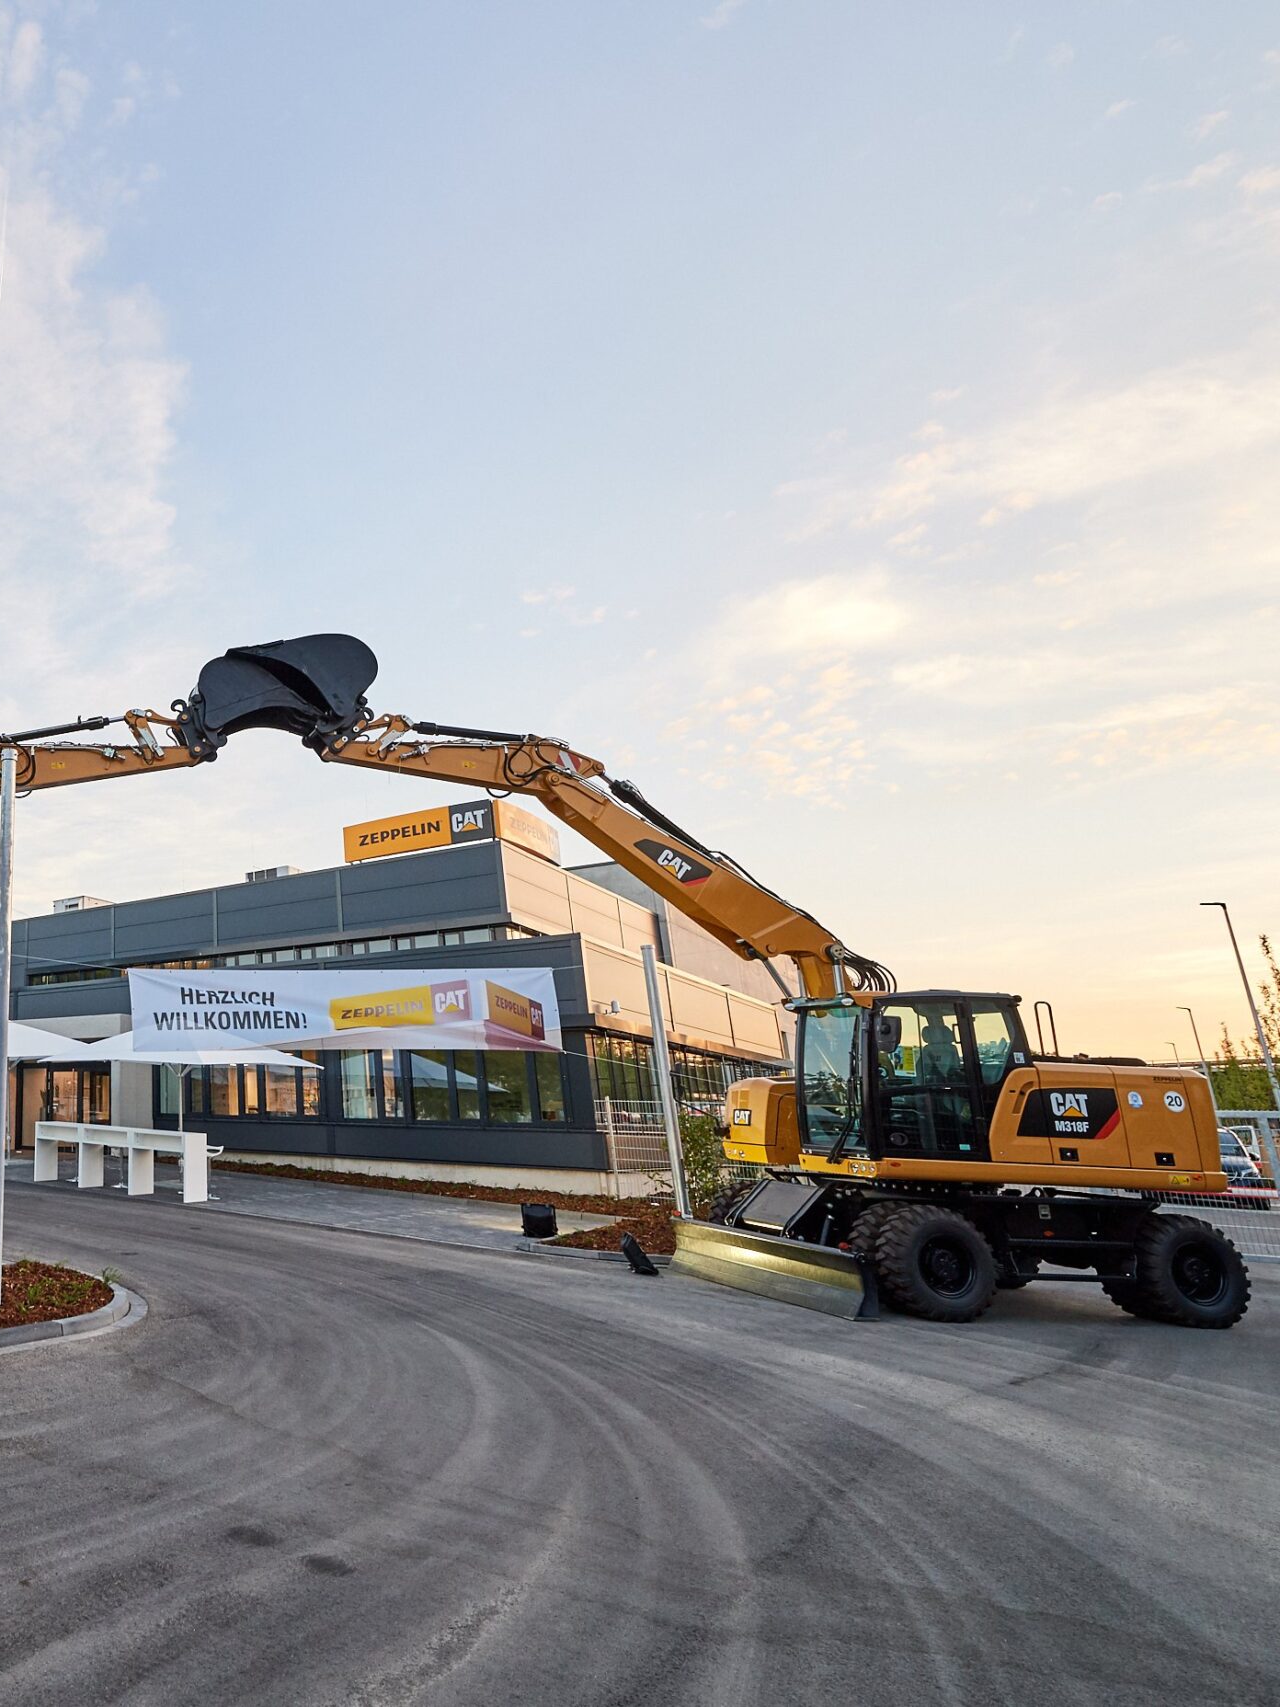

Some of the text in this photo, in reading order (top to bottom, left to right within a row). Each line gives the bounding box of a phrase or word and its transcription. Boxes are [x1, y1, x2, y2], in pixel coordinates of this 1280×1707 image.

[359, 809, 485, 846] ZEPPELIN CAT
[657, 849, 692, 880] CAT
[180, 987, 275, 1007] HERZLICH
[341, 989, 468, 1020] ZEPPELIN CAT
[495, 994, 528, 1019] ZEPPELIN
[153, 1010, 308, 1031] WILLKOMMEN!
[1050, 1092, 1089, 1118] CAT
[1166, 1095, 1183, 1107] 20
[734, 1110, 751, 1125] CAT
[1054, 1120, 1090, 1133] M318F
